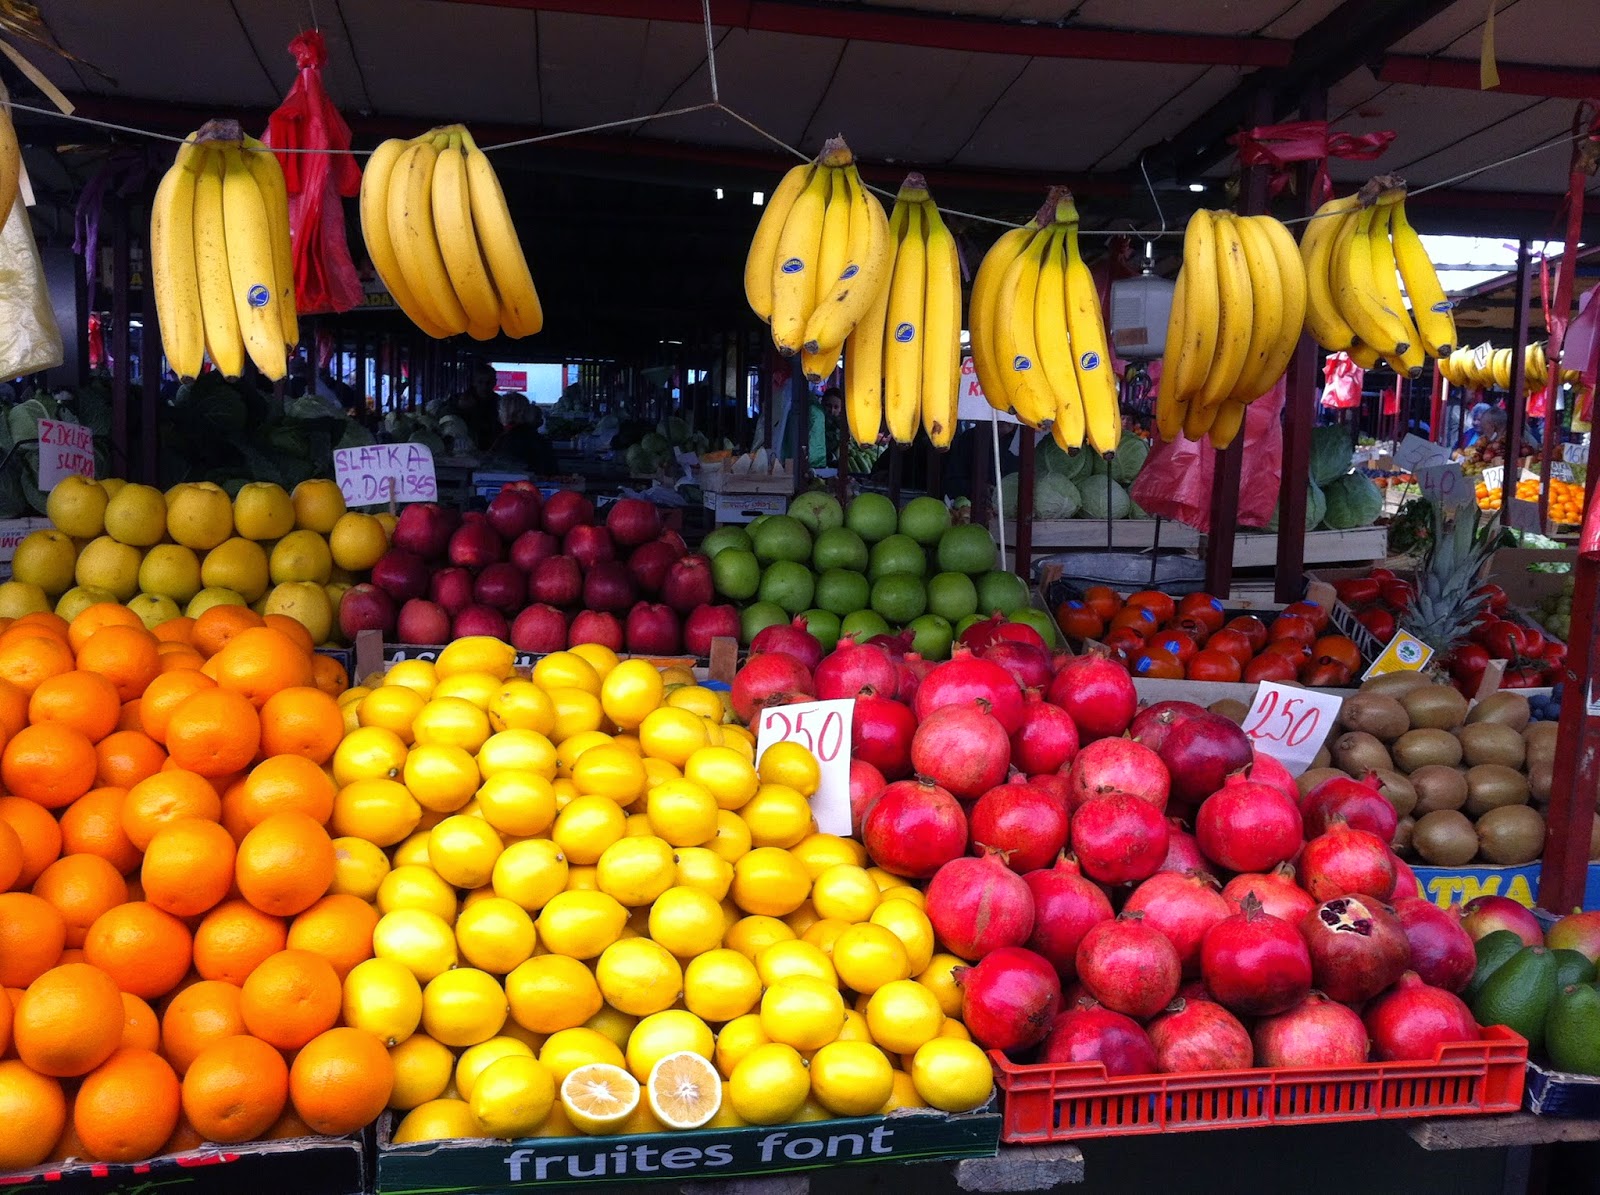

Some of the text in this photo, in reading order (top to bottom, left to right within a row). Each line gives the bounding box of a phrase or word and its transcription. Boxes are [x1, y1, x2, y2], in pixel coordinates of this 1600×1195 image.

[336, 445, 430, 472] SLATKA
[766, 708, 843, 762] 250
[1246, 690, 1320, 747] 250
[503, 1125, 895, 1182] fruites font
